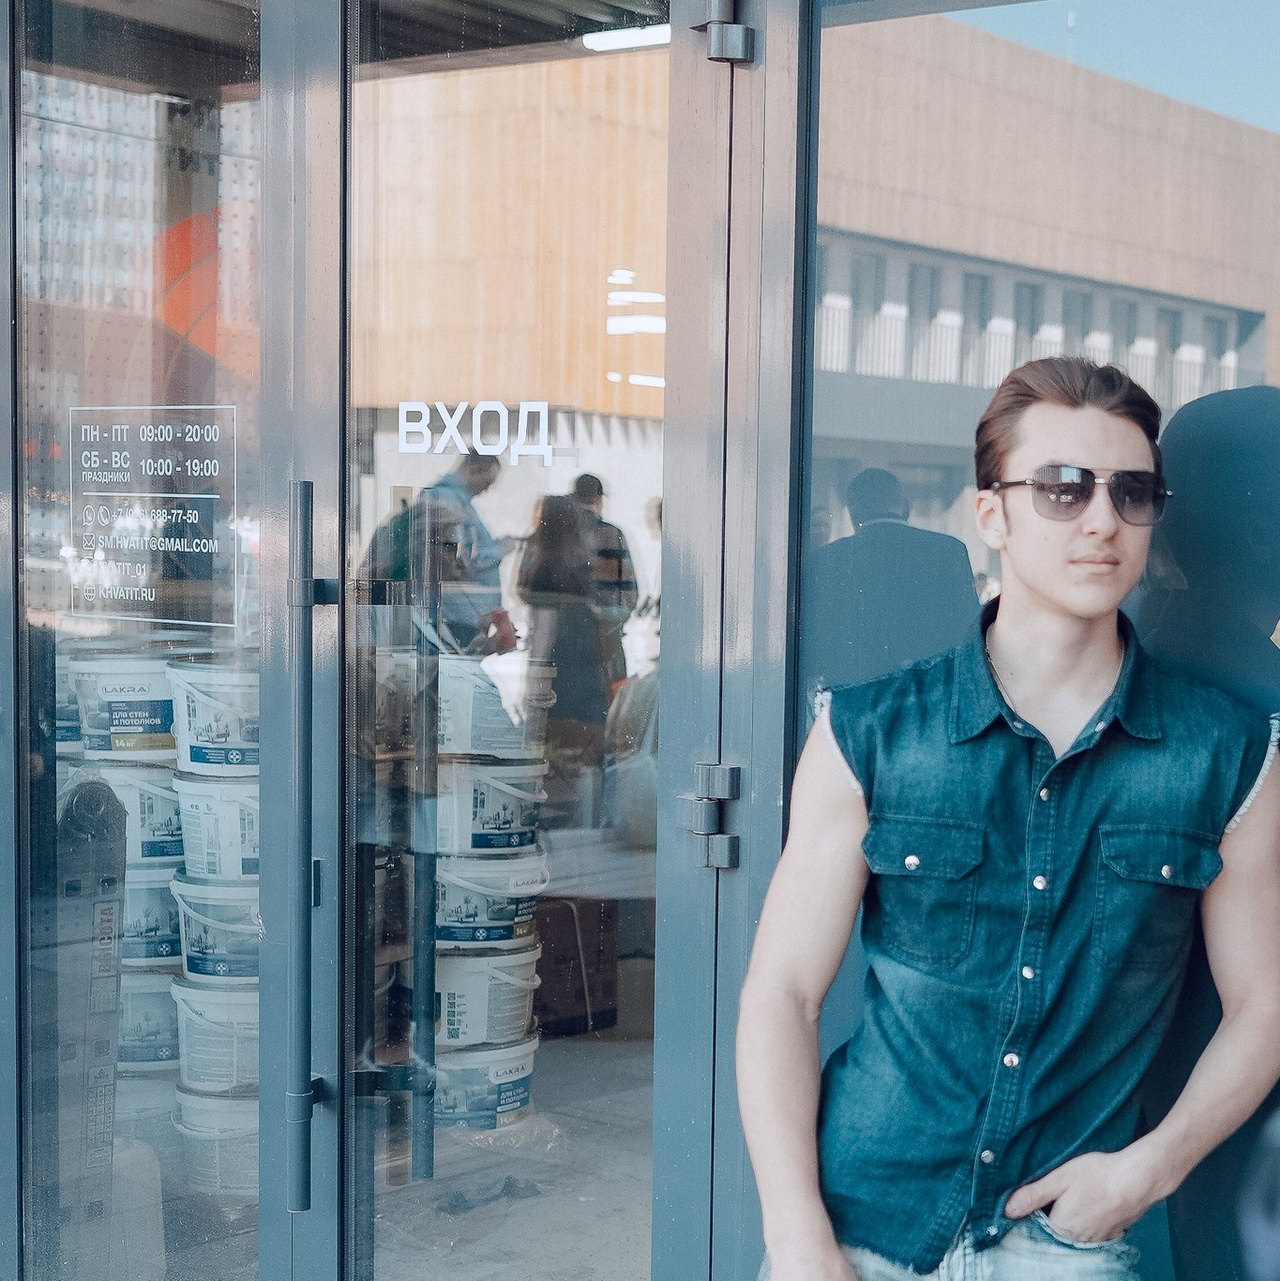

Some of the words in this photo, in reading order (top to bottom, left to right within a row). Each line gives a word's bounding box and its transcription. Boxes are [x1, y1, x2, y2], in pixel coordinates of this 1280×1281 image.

[81, 425, 100, 442] ПН
[112, 425, 130, 442] ПТ
[139, 425, 173, 442] 09:00
[185, 425, 220, 442] 20:00
[398, 401, 553, 467] ВХОД
[81, 451, 100, 468] СБ
[112, 451, 130, 468] ВС
[139, 459, 173, 476] 10:00
[185, 459, 219, 477] 19:00
[82, 471, 131, 484] ПРАЗДНИКИ
[126, 508, 148, 522] (96)
[150, 509, 199, 524] 688-77-50
[98, 586, 156, 602] KHVATIT.RU
[104, 686, 147, 694] LAKRA
[112, 711, 128, 719] ДЛЯ
[120, 717, 161, 726] ПОТОЛКОВ
[115, 739, 126, 748] 14
